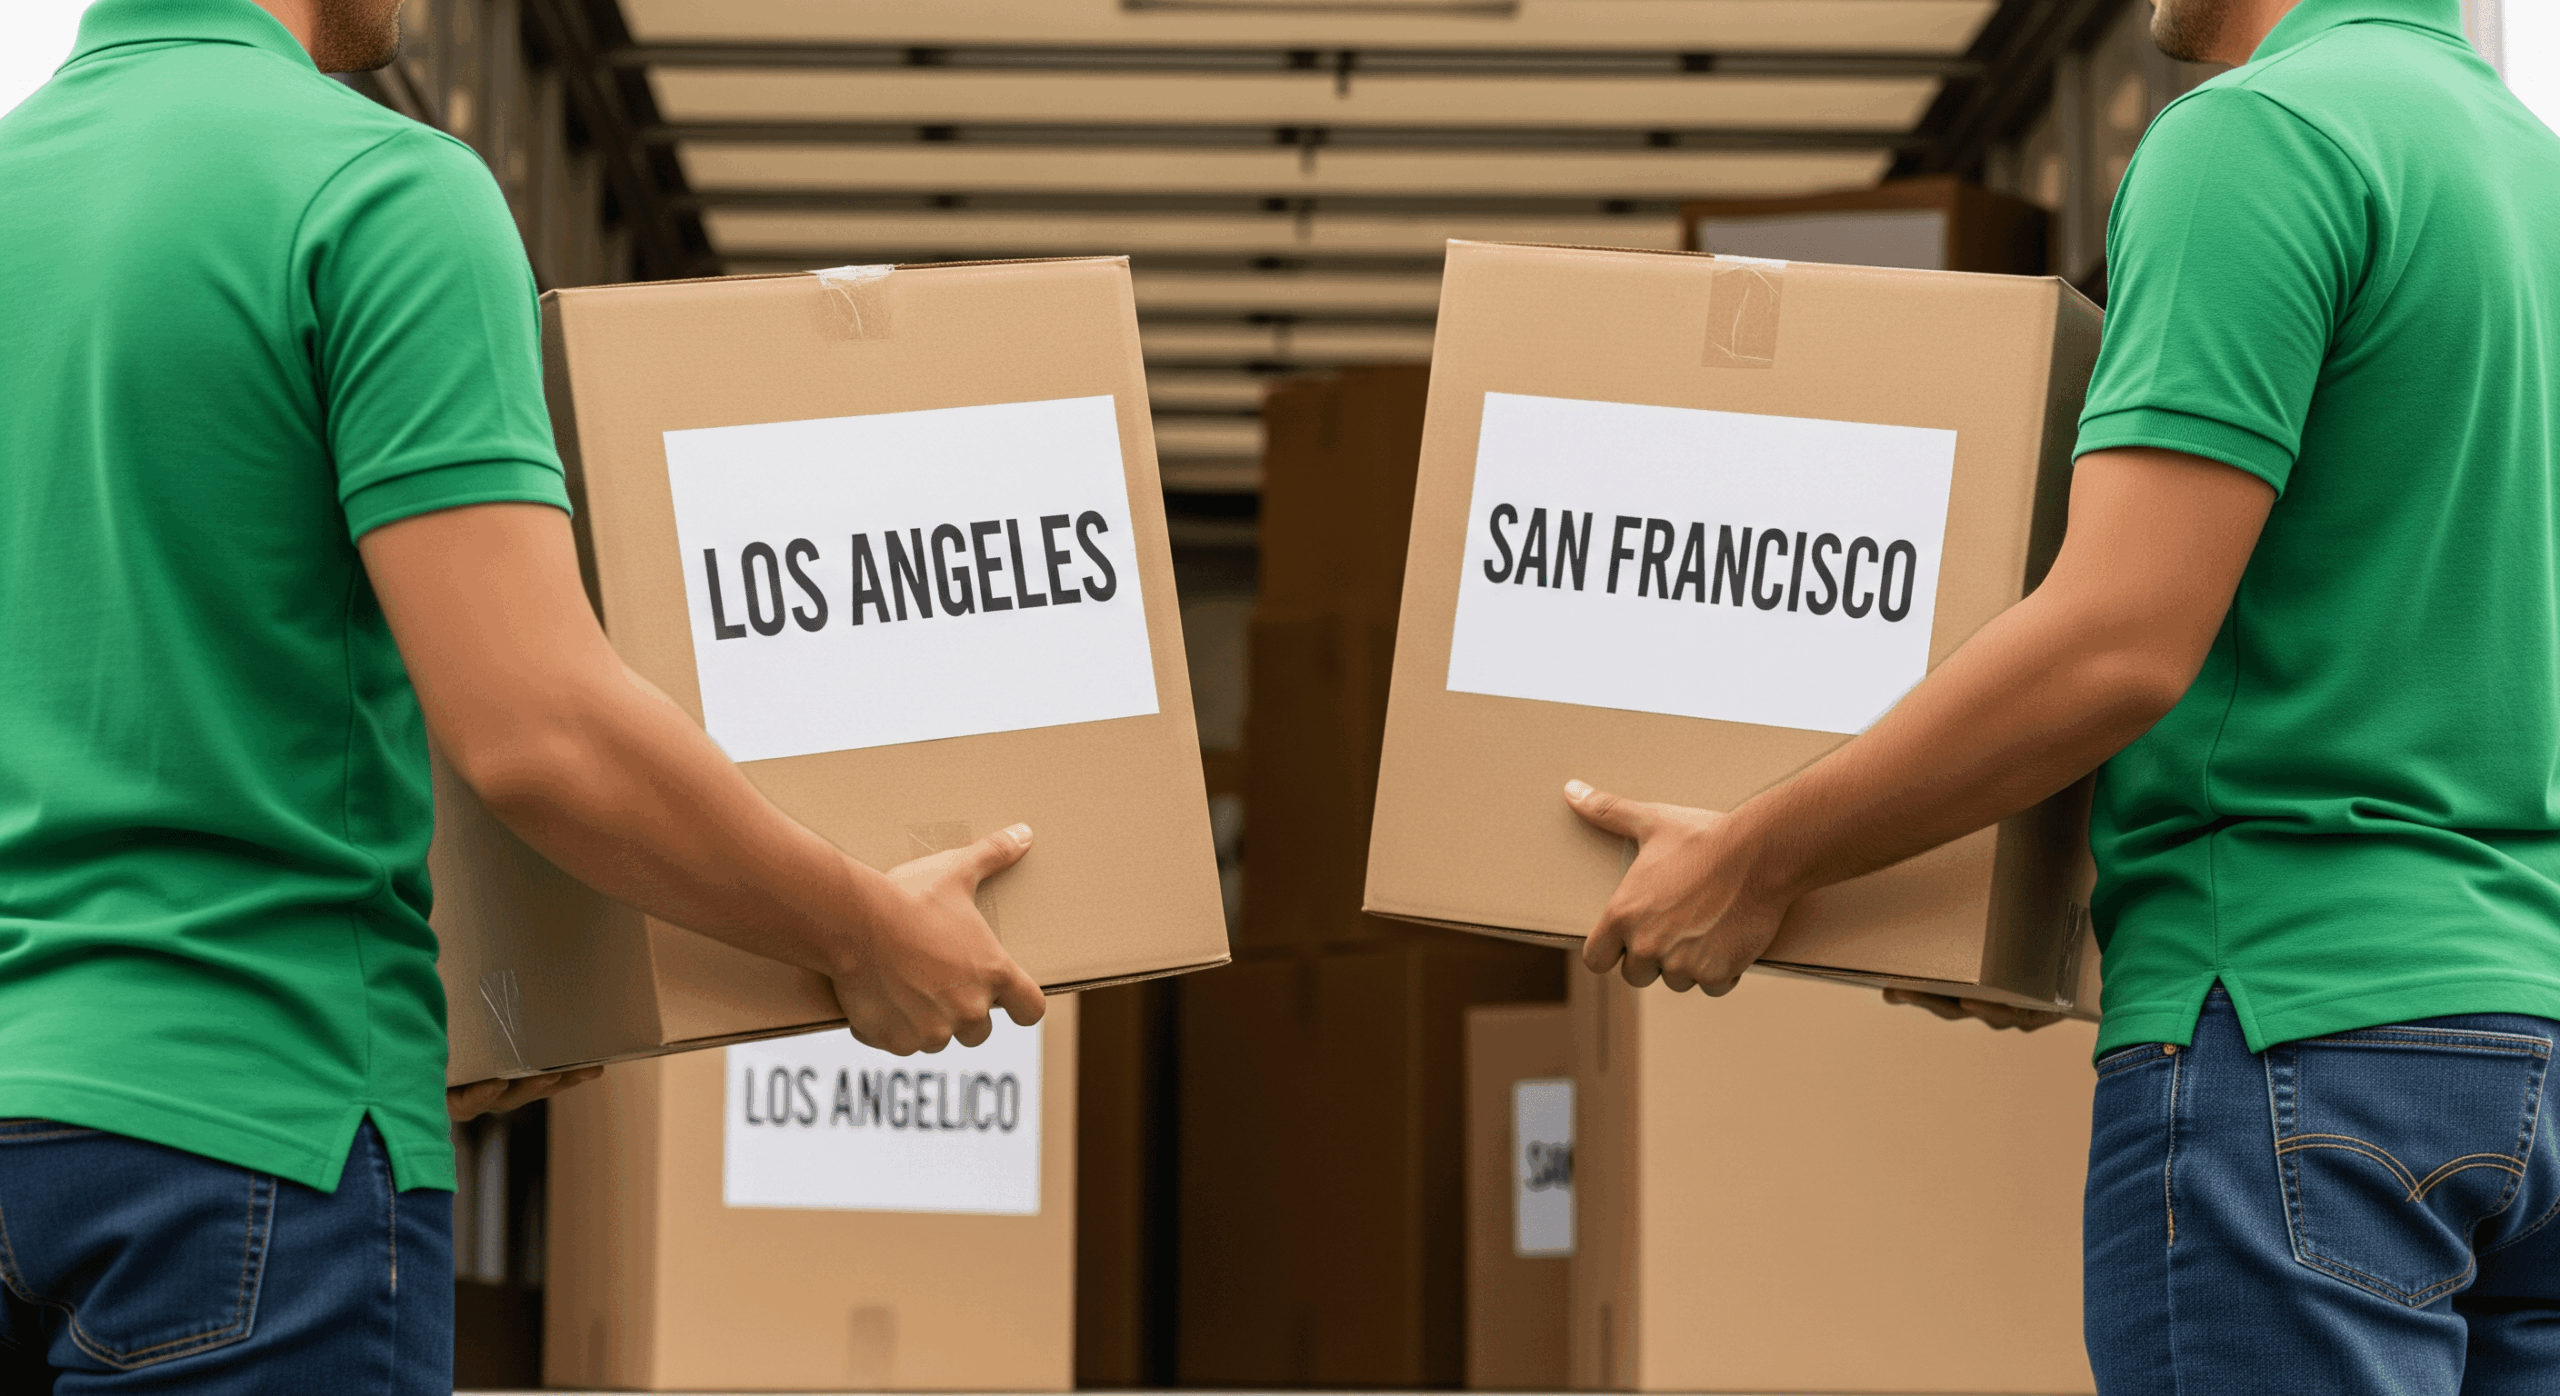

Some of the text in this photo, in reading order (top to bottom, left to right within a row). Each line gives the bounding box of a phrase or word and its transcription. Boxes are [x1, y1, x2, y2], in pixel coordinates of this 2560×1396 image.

[703, 510, 1117, 641] LOS ANGELES
[1483, 503, 1917, 622] SAN FRANCISCO
[746, 1066, 818, 1127] LOS
